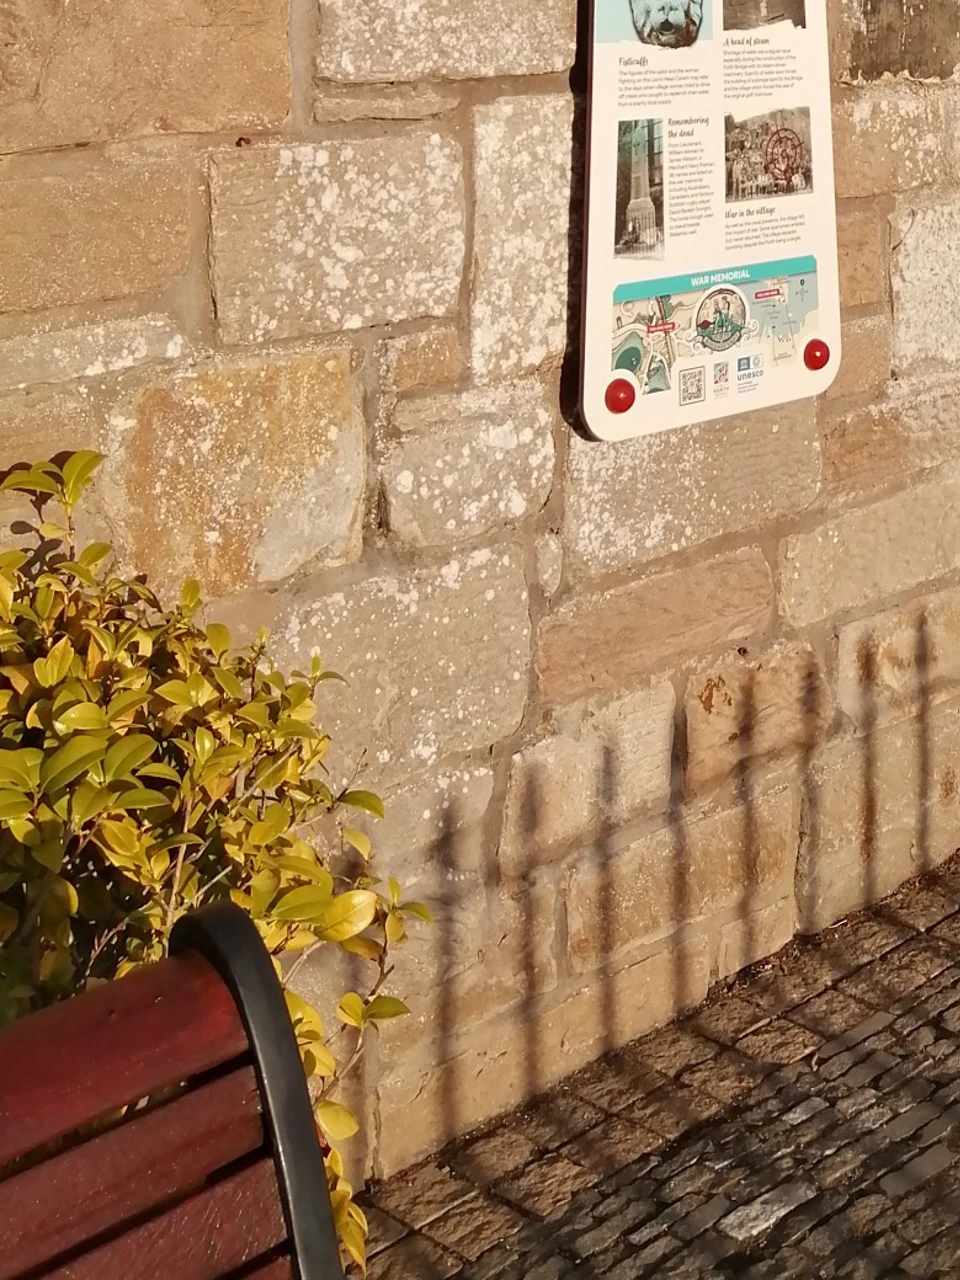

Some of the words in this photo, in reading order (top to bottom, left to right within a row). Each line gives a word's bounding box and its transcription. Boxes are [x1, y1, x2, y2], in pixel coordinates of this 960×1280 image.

[730, 37, 744, 46] head
[746, 37, 752, 46] of
[753, 37, 769, 45] steam
[668, 117, 709, 127] Remembering
[668, 130, 677, 138] the
[678, 129, 694, 137] dead
[725, 209, 737, 218] War
[745, 208, 754, 217] the
[755, 206, 776, 216] village
[691, 276, 709, 286] WAR
[711, 269, 750, 283] MEMORIAL
[737, 370, 764, 381] unesco
